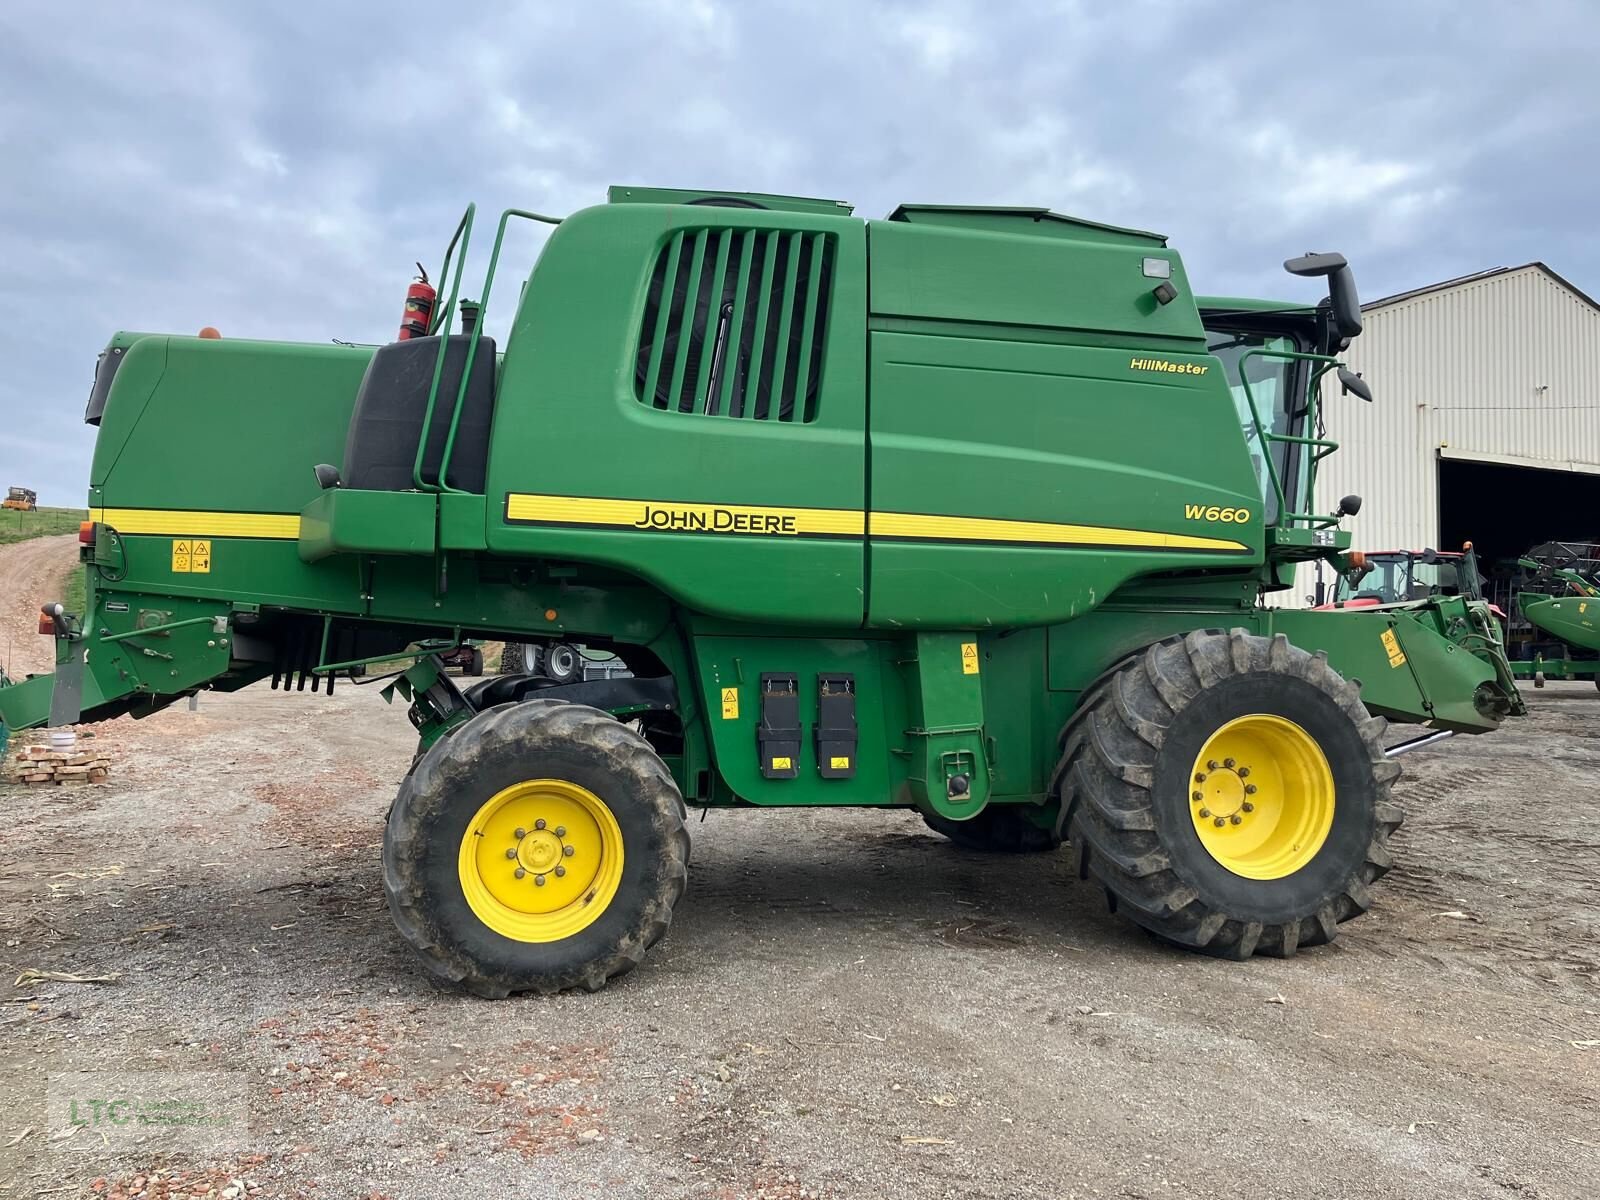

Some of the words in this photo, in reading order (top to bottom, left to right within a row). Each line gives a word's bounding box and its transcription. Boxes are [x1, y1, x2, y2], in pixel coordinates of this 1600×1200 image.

[1130, 358, 1208, 375] HillMaster
[635, 506, 706, 530] JOHN
[713, 509, 796, 532] DEERE
[1184, 504, 1250, 523] W660
